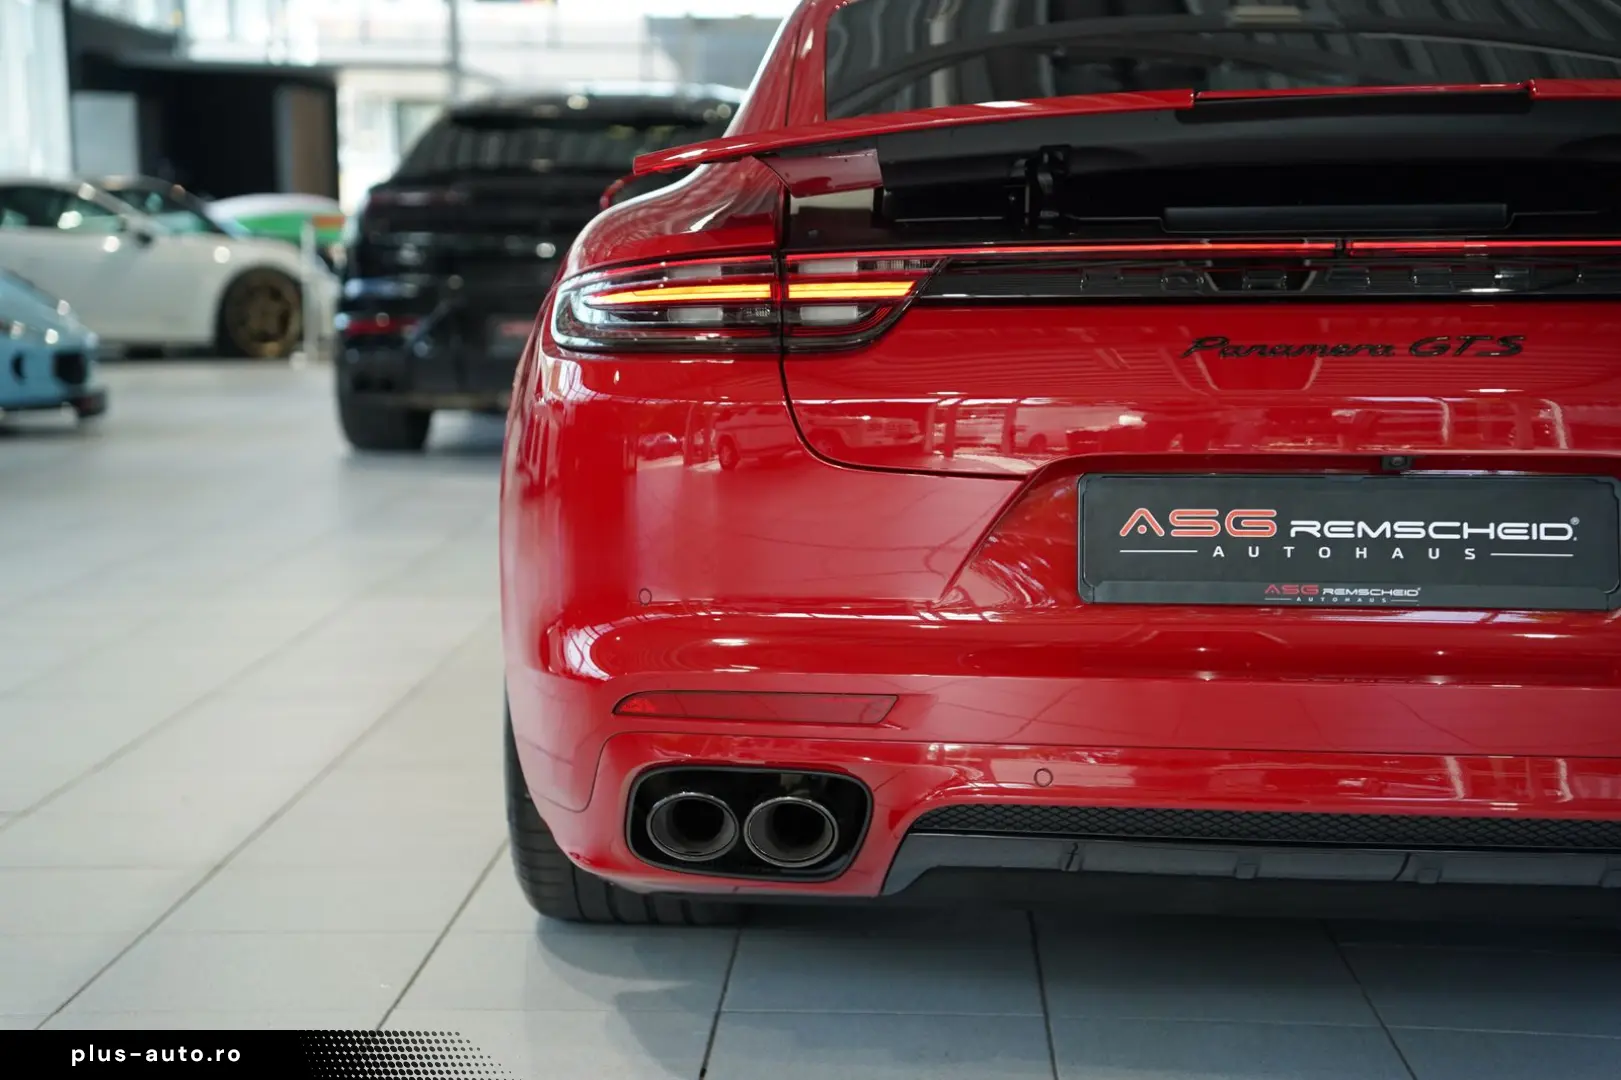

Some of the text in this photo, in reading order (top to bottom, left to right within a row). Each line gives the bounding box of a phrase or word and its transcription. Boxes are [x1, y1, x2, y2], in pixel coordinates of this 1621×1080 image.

[1181, 335, 1526, 358] Panamera GTS
[1119, 507, 1278, 538] ASG
[1213, 545, 1476, 561] AUTOHAUS
[1265, 583, 1320, 595] ASG
